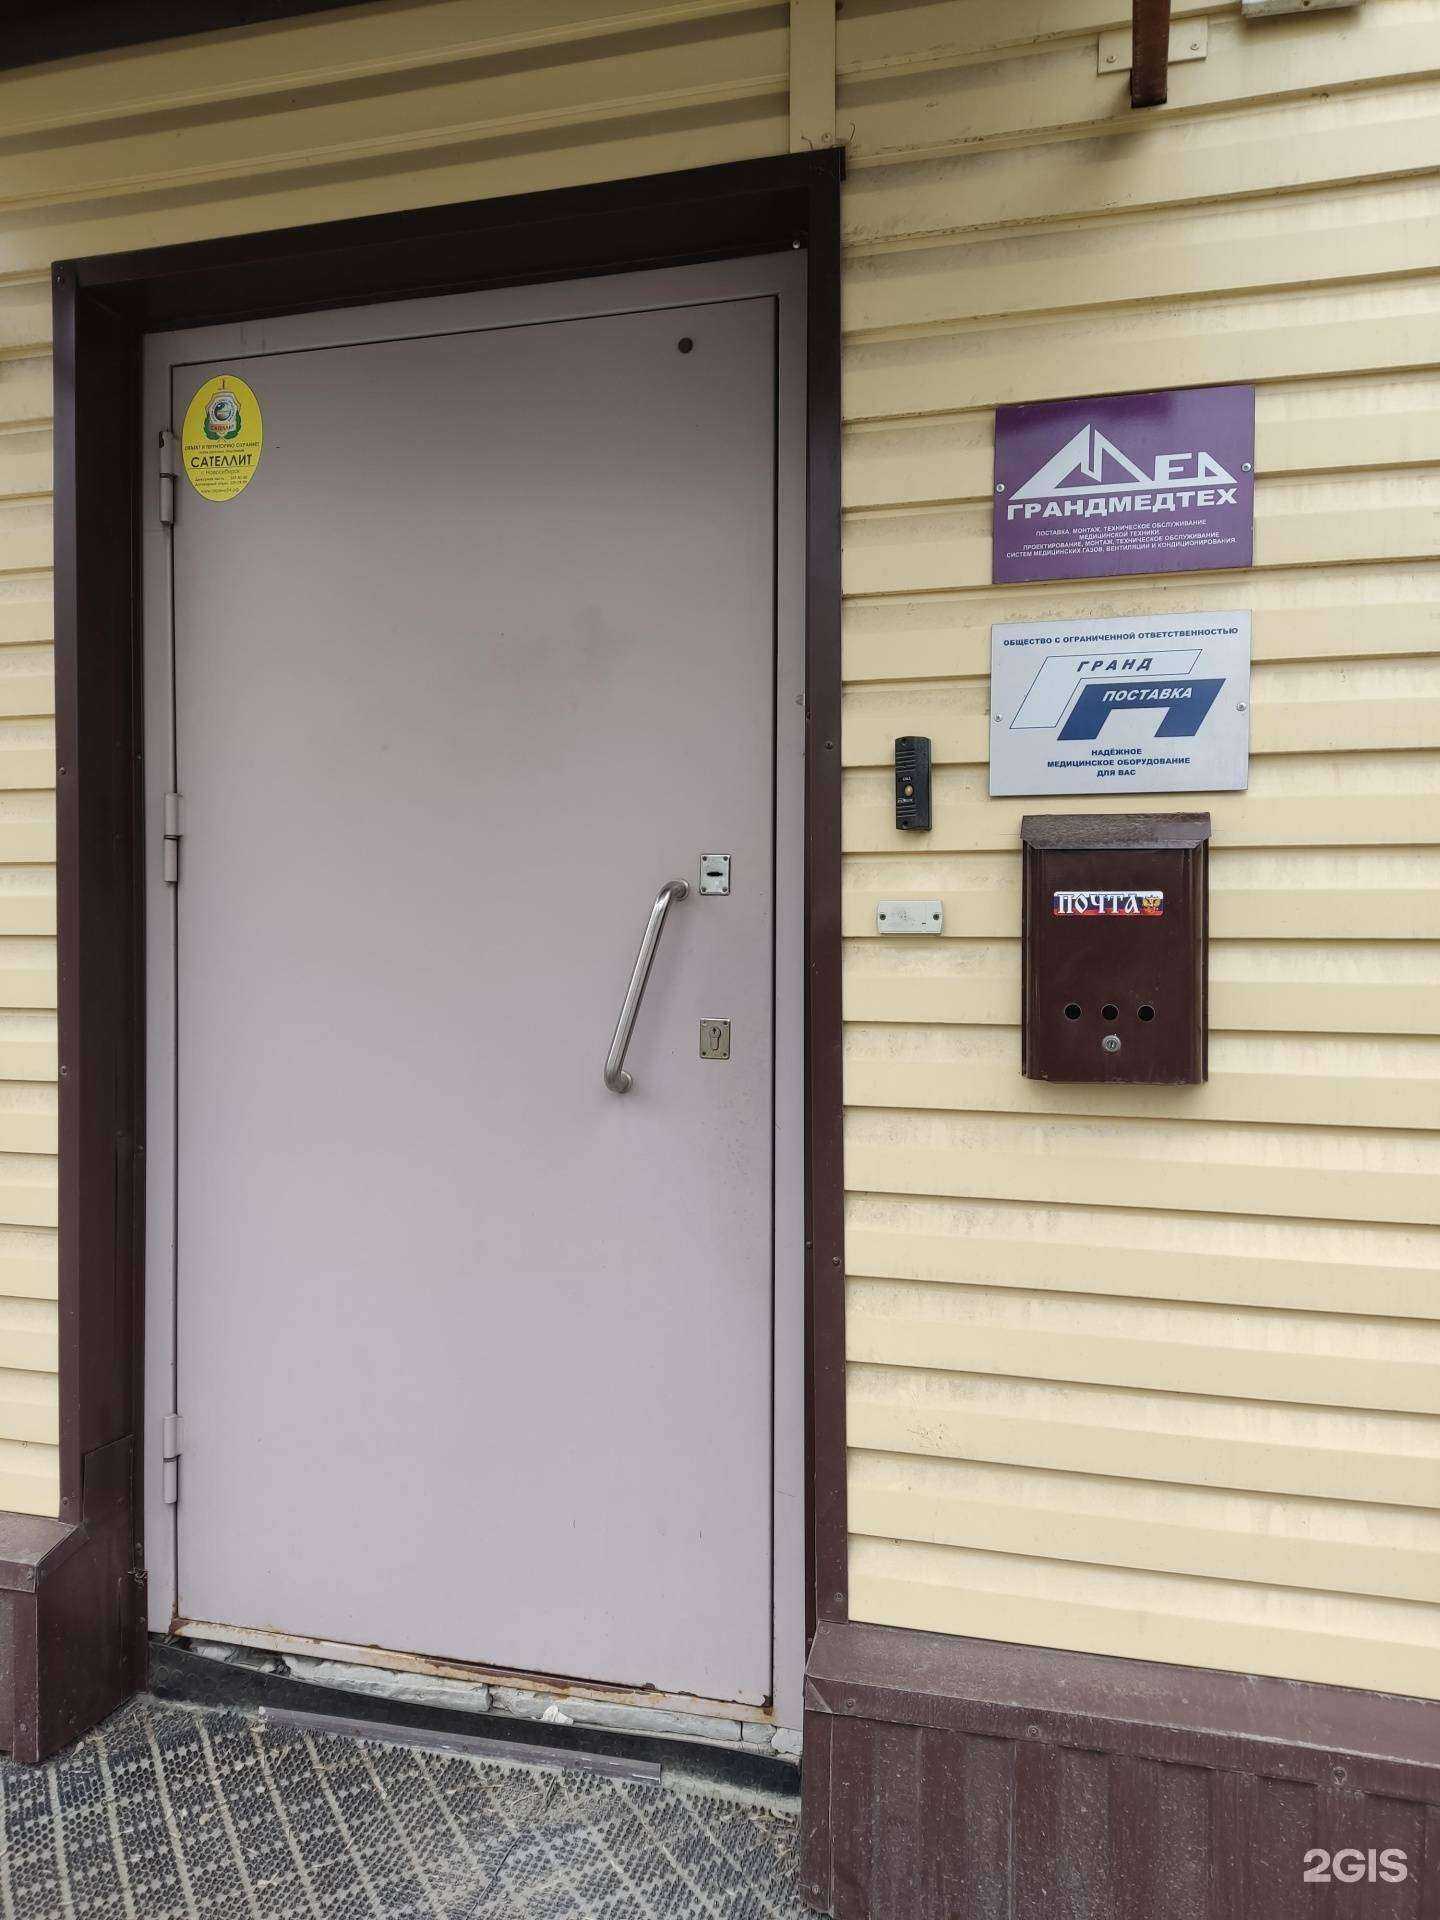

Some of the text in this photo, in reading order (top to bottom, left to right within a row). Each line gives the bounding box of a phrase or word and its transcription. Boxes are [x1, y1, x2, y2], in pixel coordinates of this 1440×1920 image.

[190, 454, 253, 468] САТЕЛЛИТ
[1007, 488, 1238, 520] ГРАНДМЕДТЕХ
[1104, 523, 1151, 532] ТЕХНИЧЕСКОЕ
[1152, 519, 1207, 528] ОБСЛУЖИВАНИЕ
[1079, 531, 1128, 540] МЕДИЦИНСКОЙ
[1116, 535, 1163, 545] ТЕХНИЧЕСКОЕ
[1165, 531, 1220, 541] ОБСЛУЖИВАНИЕ
[1034, 548, 1080, 557] МЕДИЦИНСКИХ
[1106, 543, 1150, 552] ВЕНТИЛЯЦИИ
[1003, 637, 1053, 647] ОБЩЕСТВО
[1063, 632, 1136, 644] ОГРАНИЧЕННОЙ
[1138, 627, 1239, 639] ОТВЕТСТВЕННОСТЬЮ
[1076, 657, 1154, 673] ГРАНД
[1102, 687, 1193, 702] ПОСТАВКА
[1091, 747, 1142, 757] НАДЁЖНОЕ
[1047, 757, 1191, 768] МЕДИЦИНСКОЕ ОБОРУДОВАНИЕ
[1096, 769, 1136, 777] ДЛЯ ВАС
[1057, 893, 1141, 914] ПОЧТА
